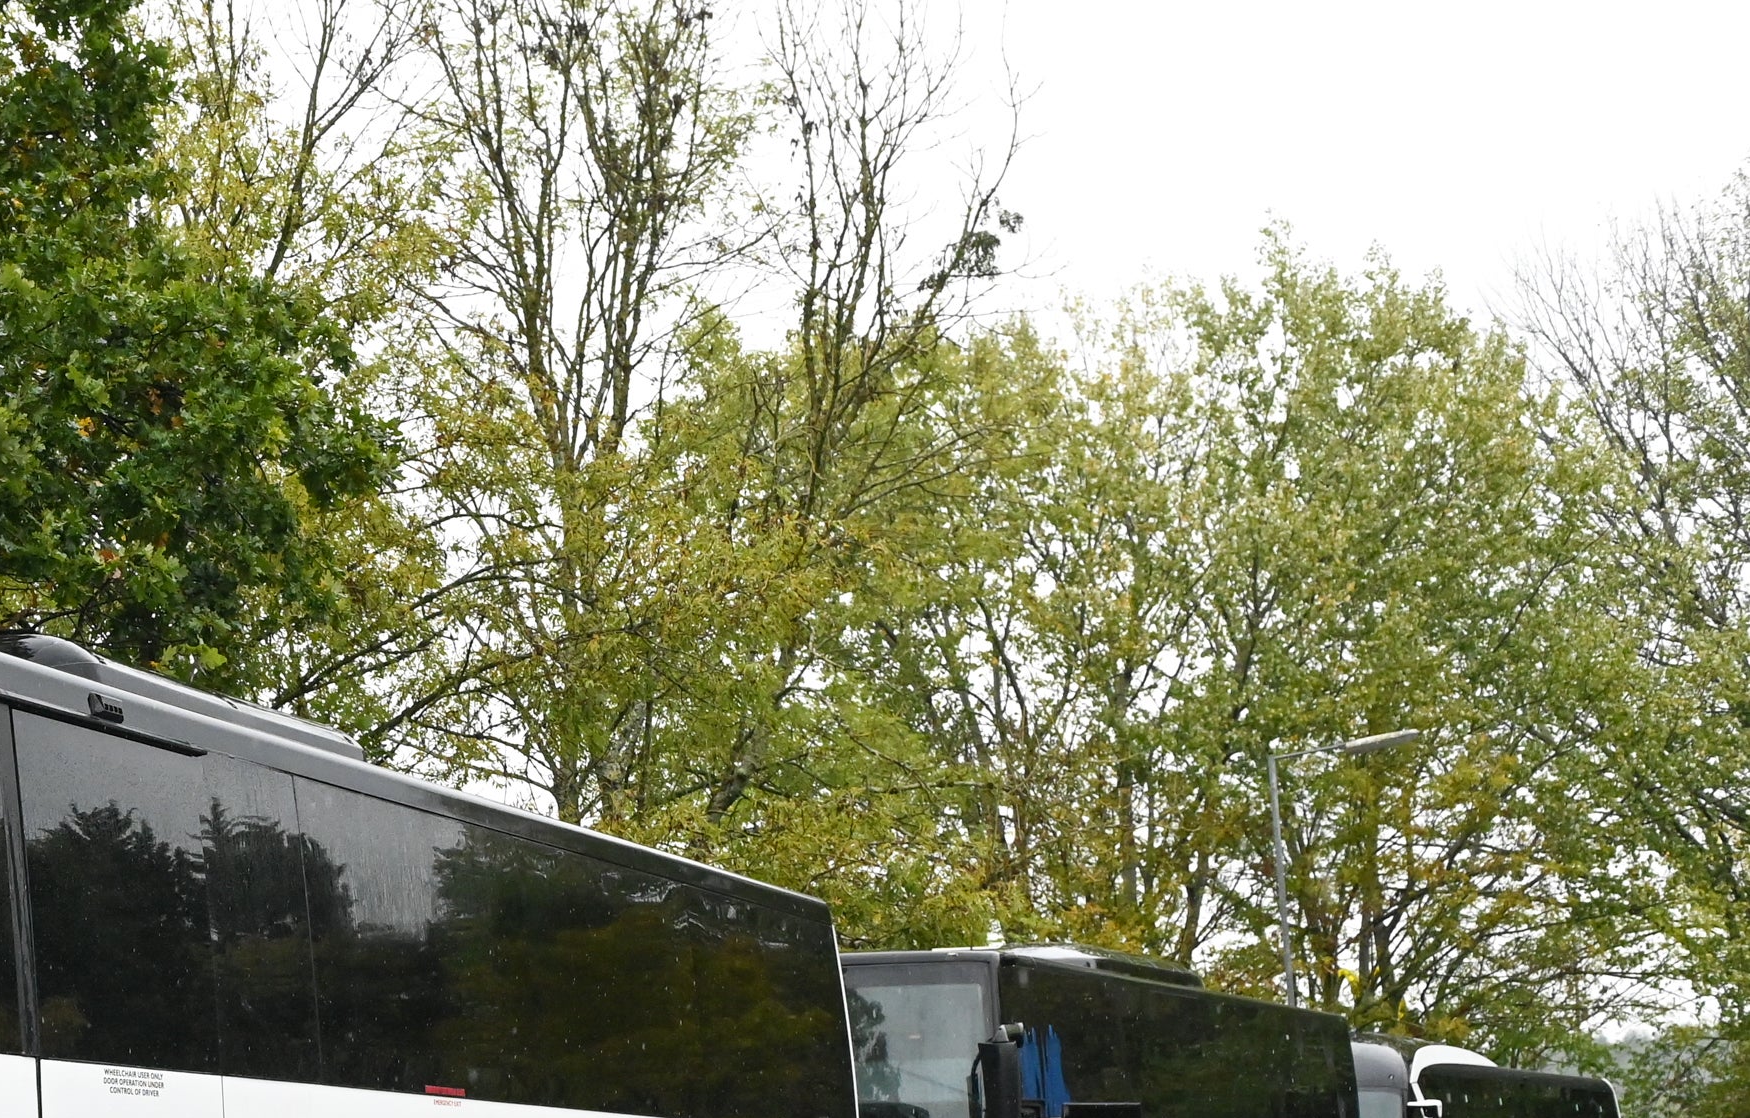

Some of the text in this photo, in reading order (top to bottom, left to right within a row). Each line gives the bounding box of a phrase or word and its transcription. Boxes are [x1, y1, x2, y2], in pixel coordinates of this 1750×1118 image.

[104, 1068, 163, 1080] WHEELCHAIR USER ONLY
[103, 1077, 164, 1089] DOOR OPERATION UNDER
[110, 1086, 159, 1097] CONTROL OF DRIVER
